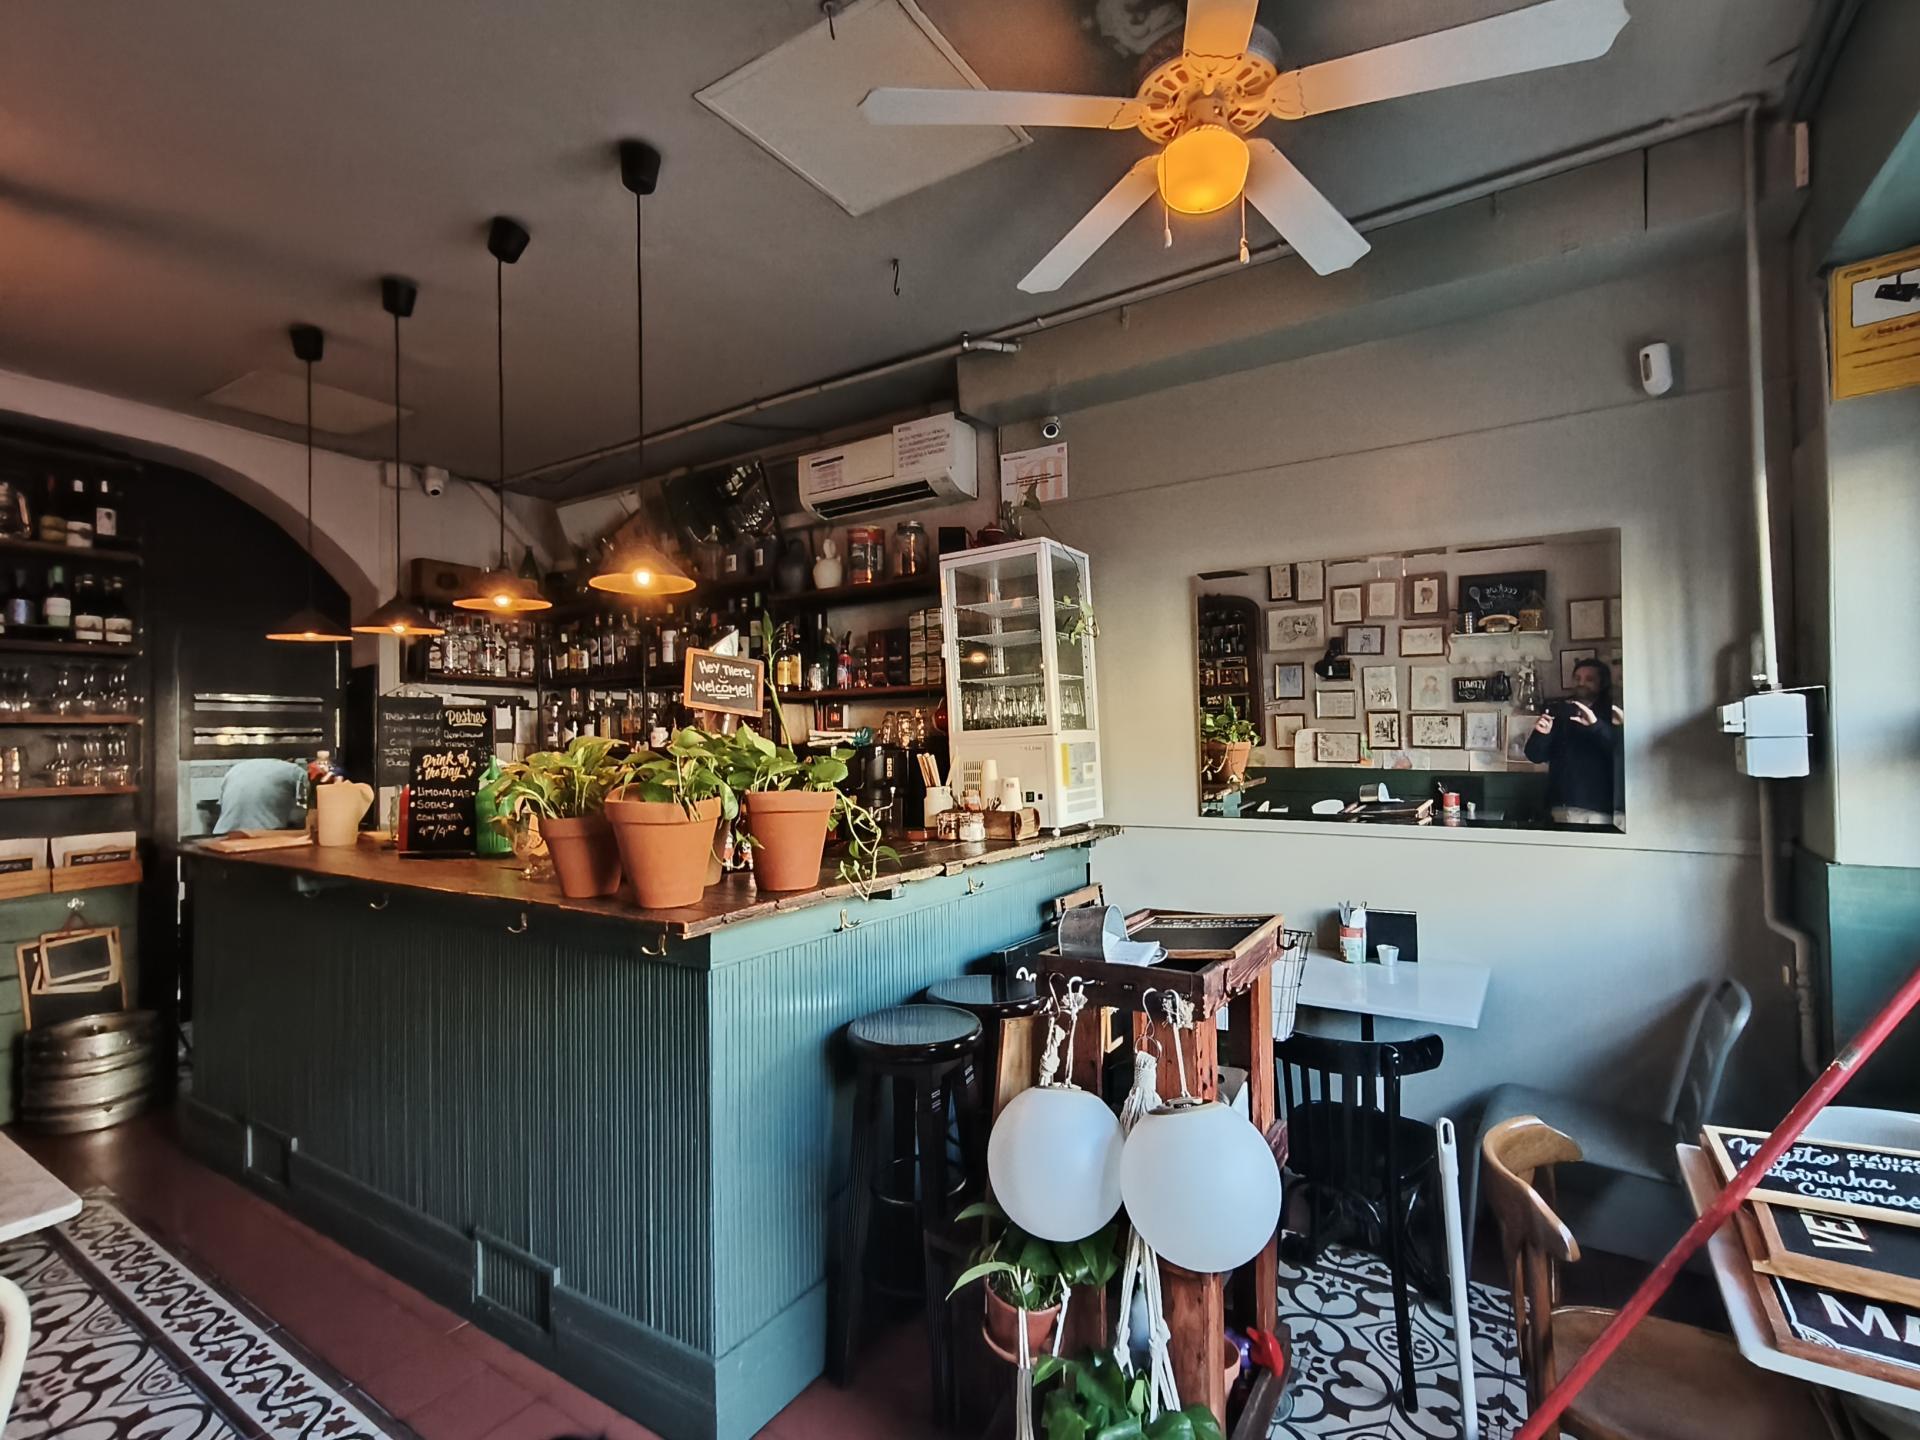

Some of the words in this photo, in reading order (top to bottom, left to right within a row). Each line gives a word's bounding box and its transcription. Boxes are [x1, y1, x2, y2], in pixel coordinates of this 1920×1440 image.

[699, 660, 720, 674] Hey
[445, 708, 487, 725] Postres
[422, 750, 458, 768] Drink
[457, 750, 470, 768] of
[425, 767, 440, 781] the
[440, 767, 467, 782] Day
[417, 786, 470, 798] LIMONADAS
[417, 800, 449, 809] SODAS
[1727, 1137, 1840, 1170] Mjito
[1740, 1159, 1897, 1191] ipirinha
[1799, 1209, 1873, 1252] VE
